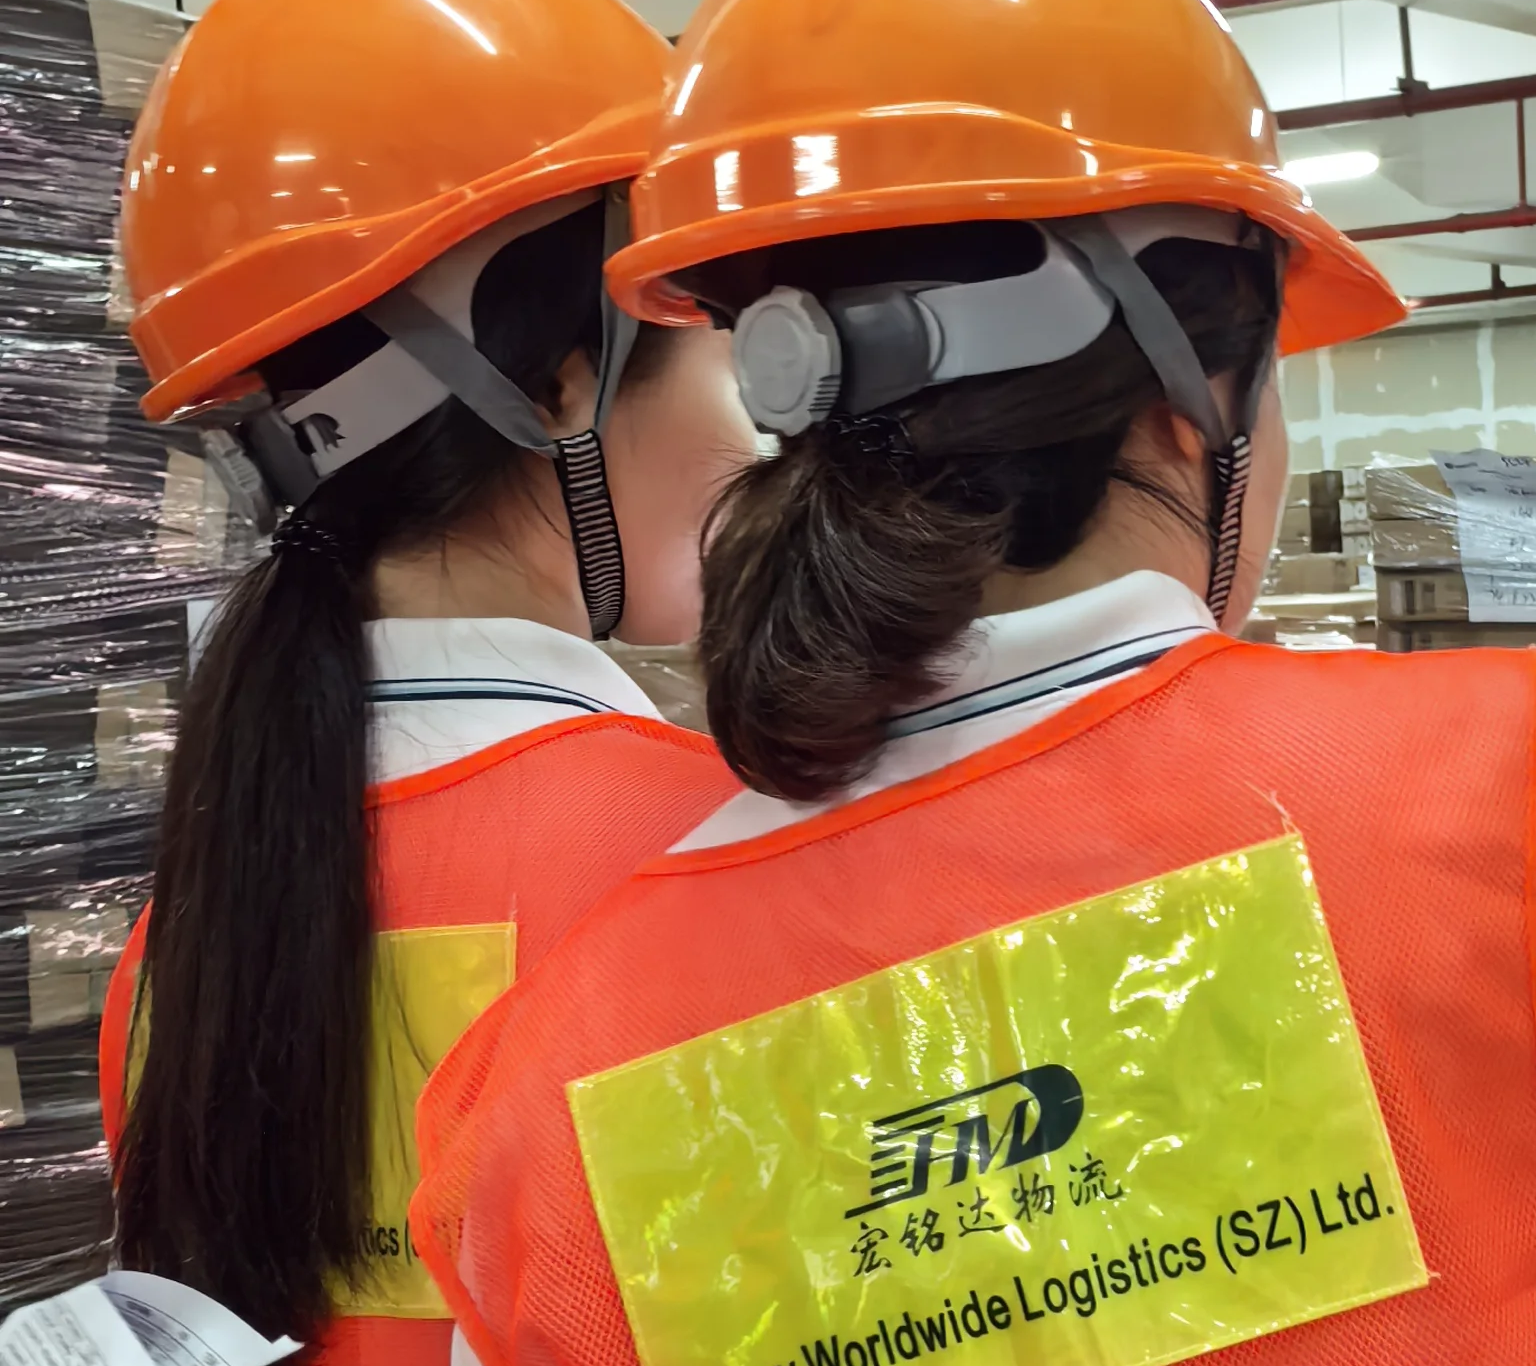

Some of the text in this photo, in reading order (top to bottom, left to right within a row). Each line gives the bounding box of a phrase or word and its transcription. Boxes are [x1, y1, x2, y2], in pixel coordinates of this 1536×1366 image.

[850, 1151, 1124, 1277] 宏铭达物流
[1013, 1236, 1207, 1321] Logistics
[1216, 1195, 1307, 1274] (SZ)
[1311, 1173, 1394, 1234] Ltd.
